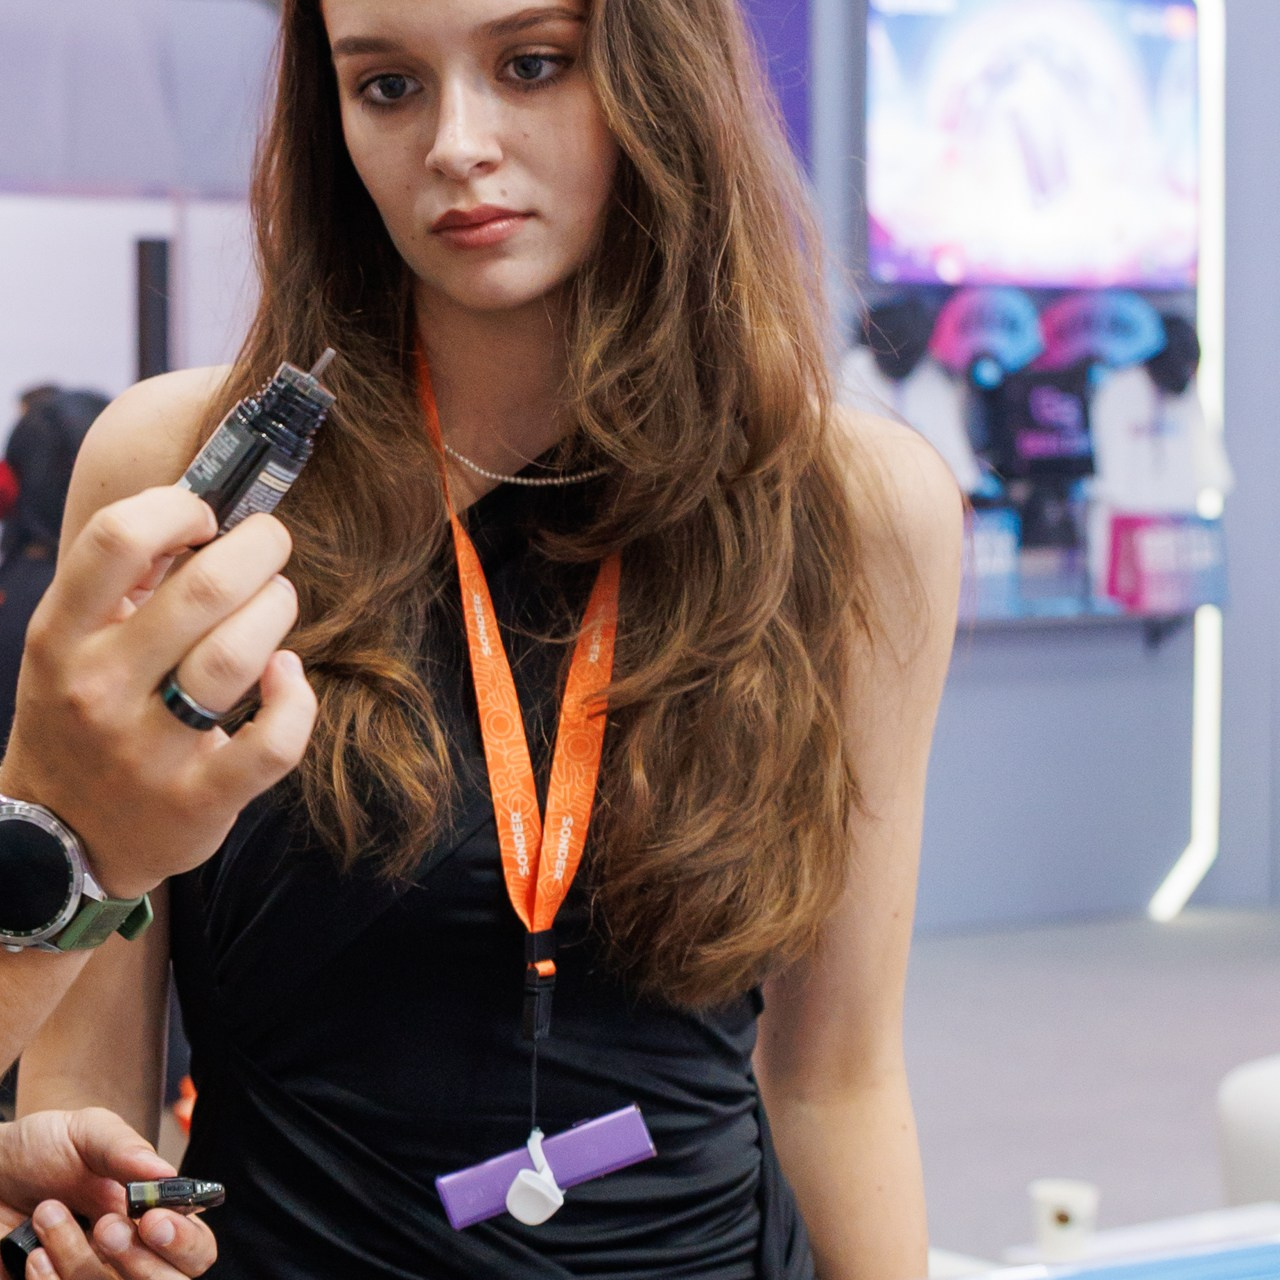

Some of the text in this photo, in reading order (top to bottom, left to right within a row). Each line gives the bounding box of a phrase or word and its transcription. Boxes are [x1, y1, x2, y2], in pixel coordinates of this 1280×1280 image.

[473, 594, 492, 657] SONDER
[510, 811, 530, 877] SONDER
[553, 816, 573, 880] SONDER
